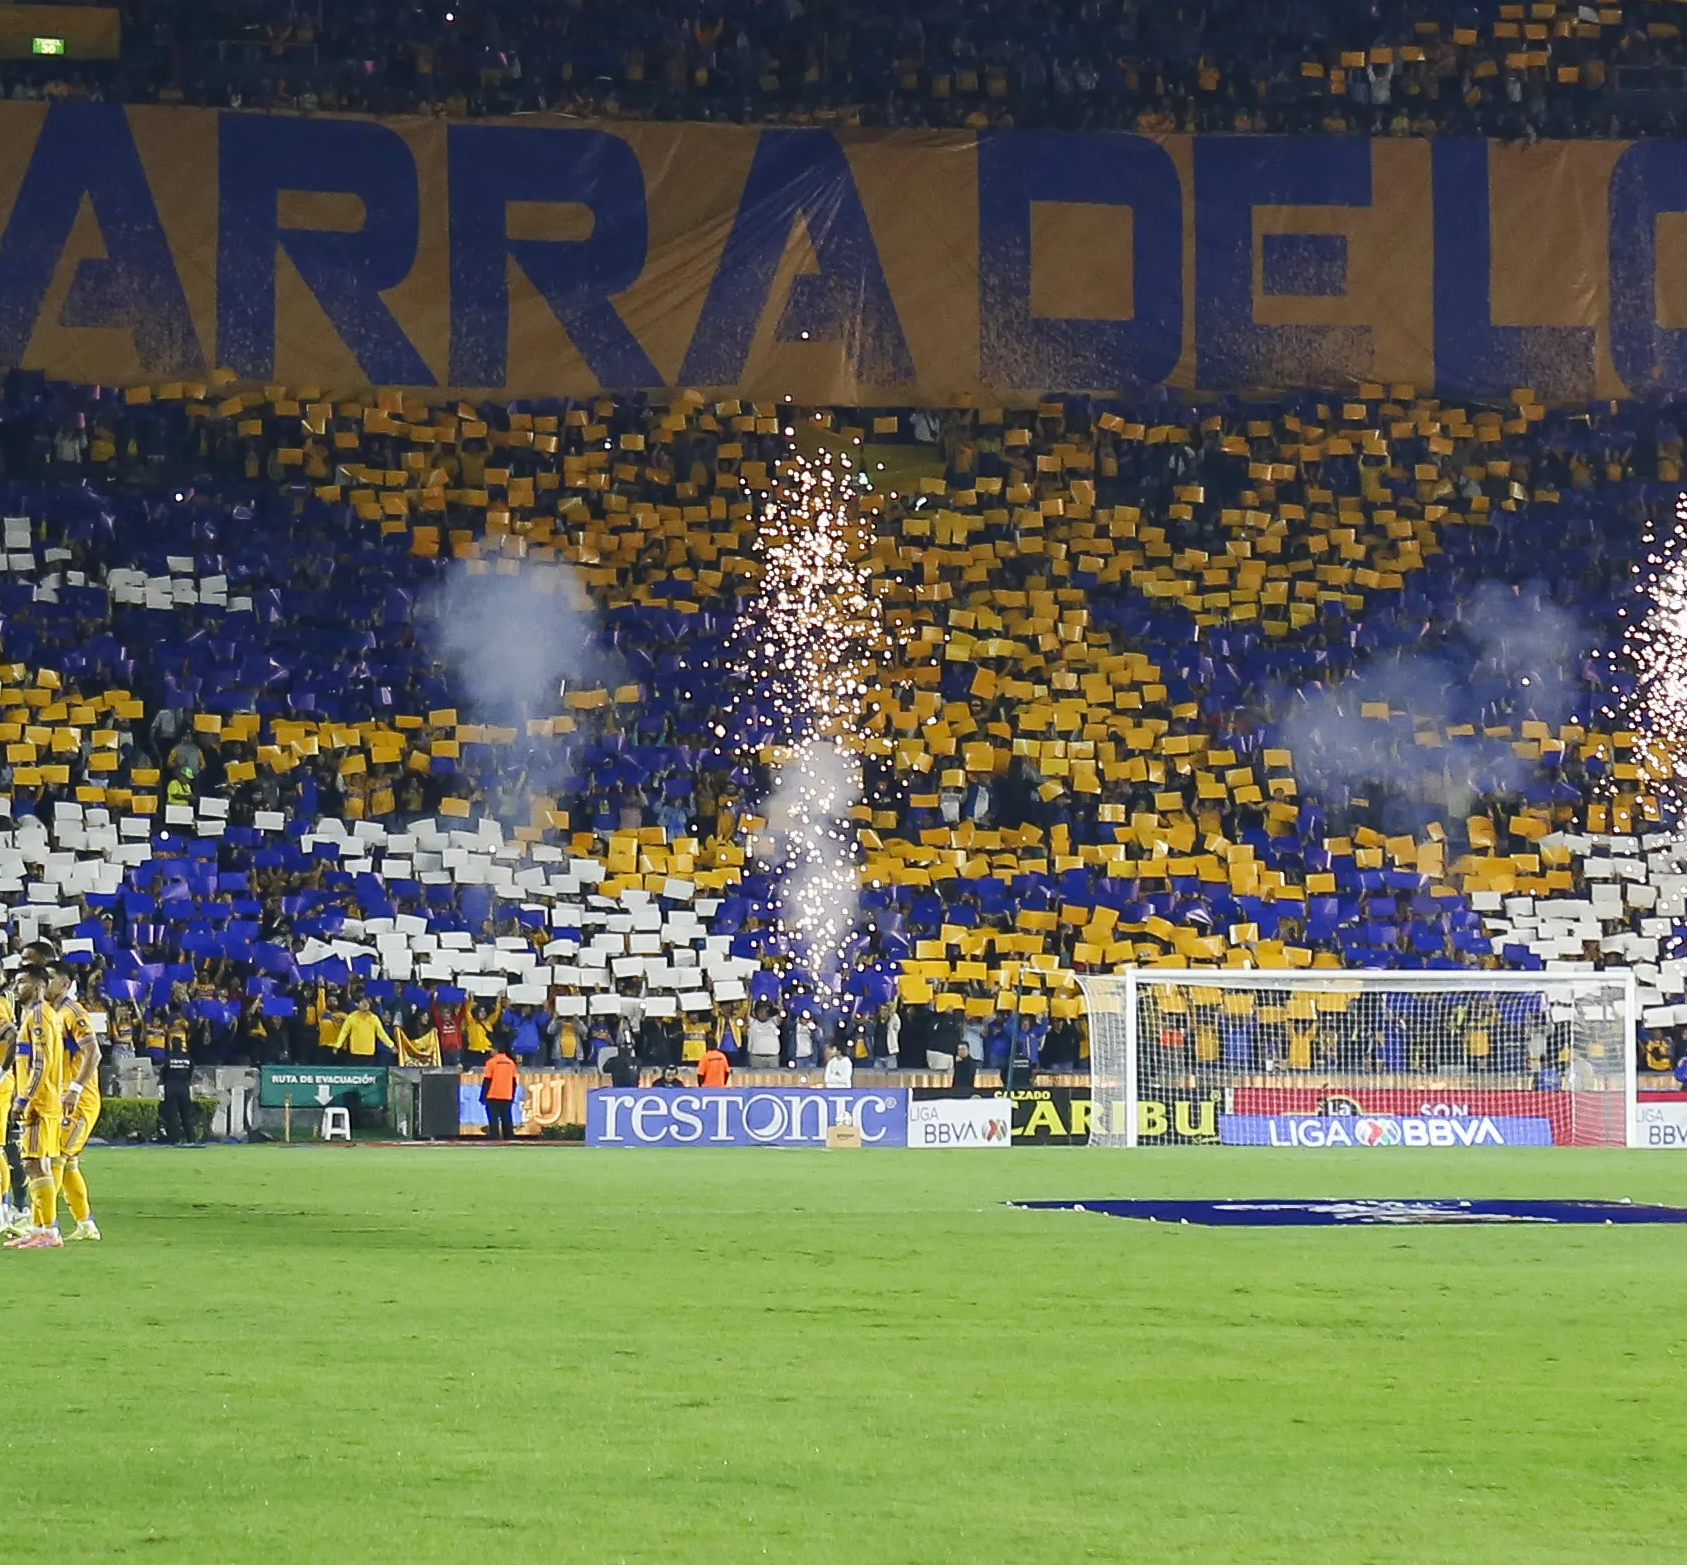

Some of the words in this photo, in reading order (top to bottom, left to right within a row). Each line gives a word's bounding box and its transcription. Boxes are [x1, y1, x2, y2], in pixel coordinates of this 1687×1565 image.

[978, 131, 1374, 393] DE
[271, 1075, 299, 1084] RUTA
[299, 1075, 314, 1084] DE
[315, 1073, 376, 1085] EVACUACIÓN
[909, 1106, 939, 1123] LIGA
[1420, 1103, 1469, 1117] SON
[924, 1120, 977, 1144] BBVA
[1269, 1119, 1352, 1147] LIGA
[1402, 1117, 1505, 1147] BBVA
